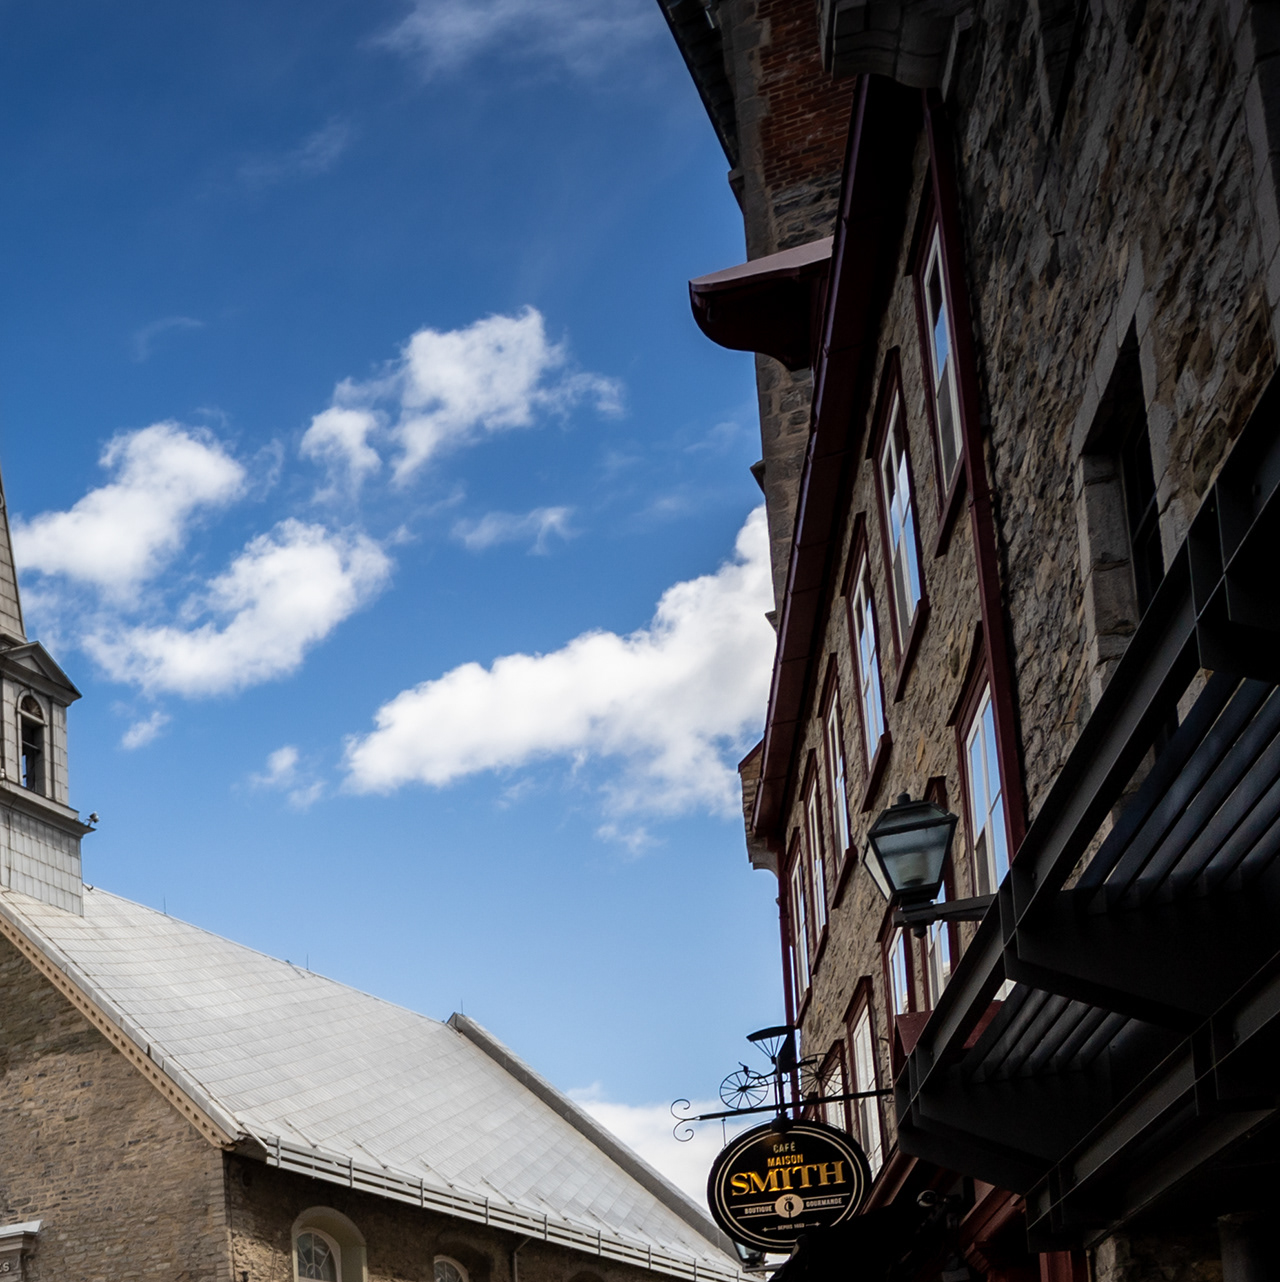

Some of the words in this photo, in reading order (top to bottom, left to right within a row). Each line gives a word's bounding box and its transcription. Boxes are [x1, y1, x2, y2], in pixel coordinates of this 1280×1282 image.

[773, 1141, 796, 1153] CAFÉ
[767, 1154, 804, 1167] MAISON
[730, 1161, 846, 1196] SMITH
[744, 1205, 773, 1215] BOUTIQUE
[805, 1197, 843, 1207] GOURMANDE
